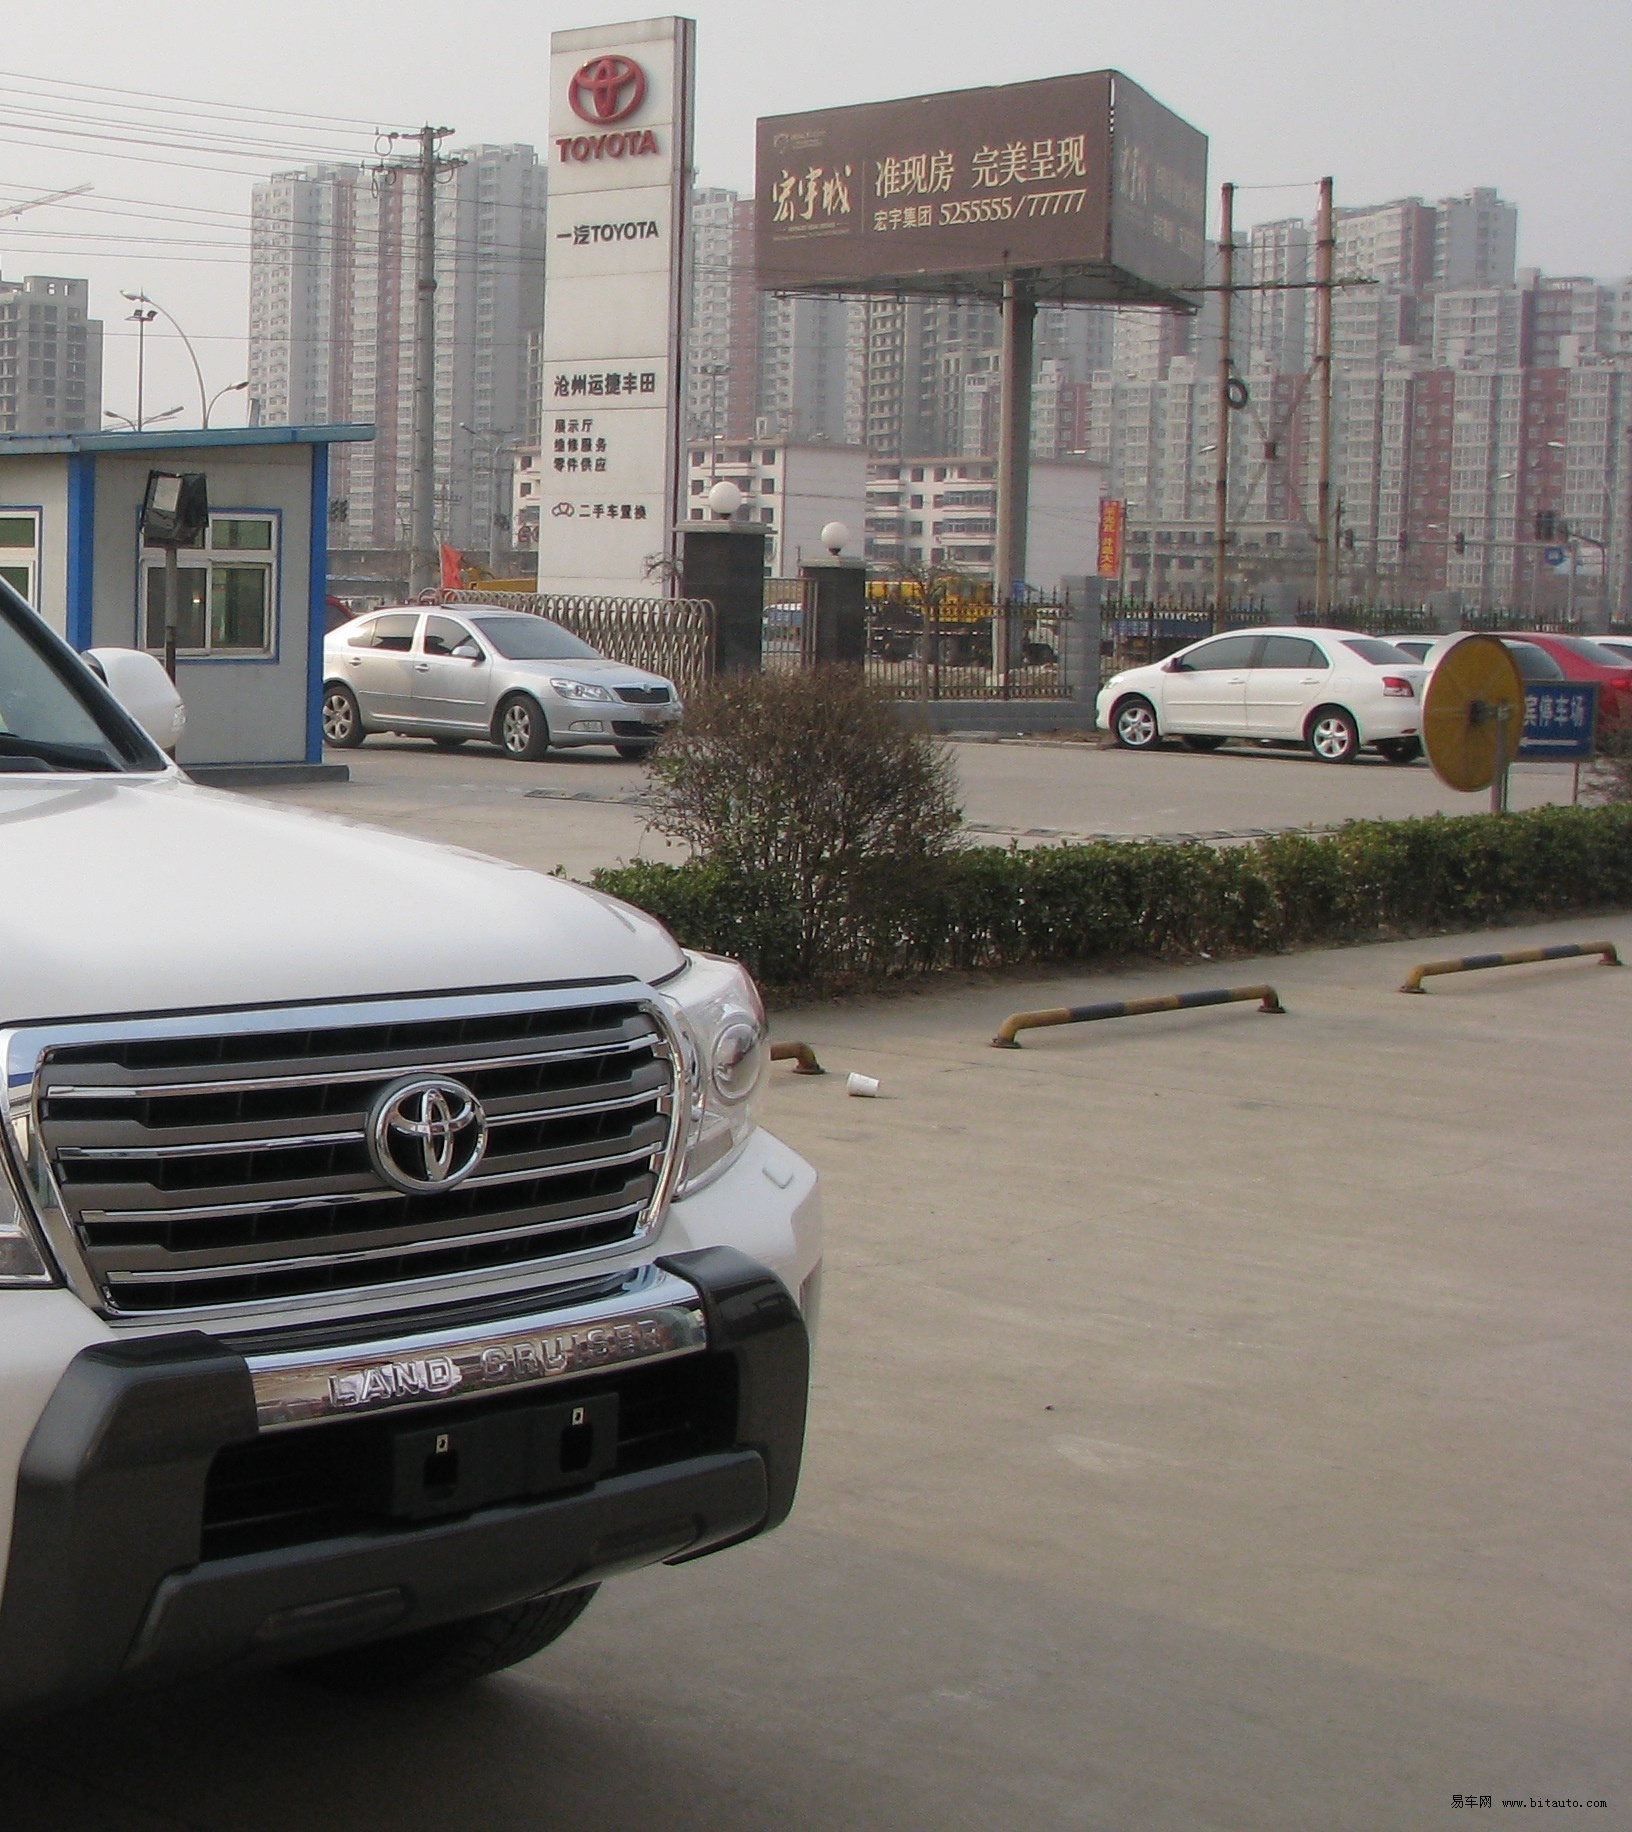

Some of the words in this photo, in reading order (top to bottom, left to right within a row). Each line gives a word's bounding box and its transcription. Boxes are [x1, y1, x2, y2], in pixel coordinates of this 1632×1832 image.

[555, 130, 659, 163] TOYOTA
[874, 150, 956, 199] 准现房
[971, 134, 1088, 189] 完美呈现
[873, 204, 933, 232] 宏宇集团
[556, 220, 659, 245] 一汽TOYOTA
[554, 373, 656, 397] 沧州运捷丰田
[554, 419, 593, 433] 展示厅
[554, 438, 607, 453] 维修服务
[554, 457, 607, 472] 零件供应
[579, 504, 647, 519] 二手车置换
[328, 1355, 463, 1407] LAND
[481, 1319, 661, 1381] CRUISER
